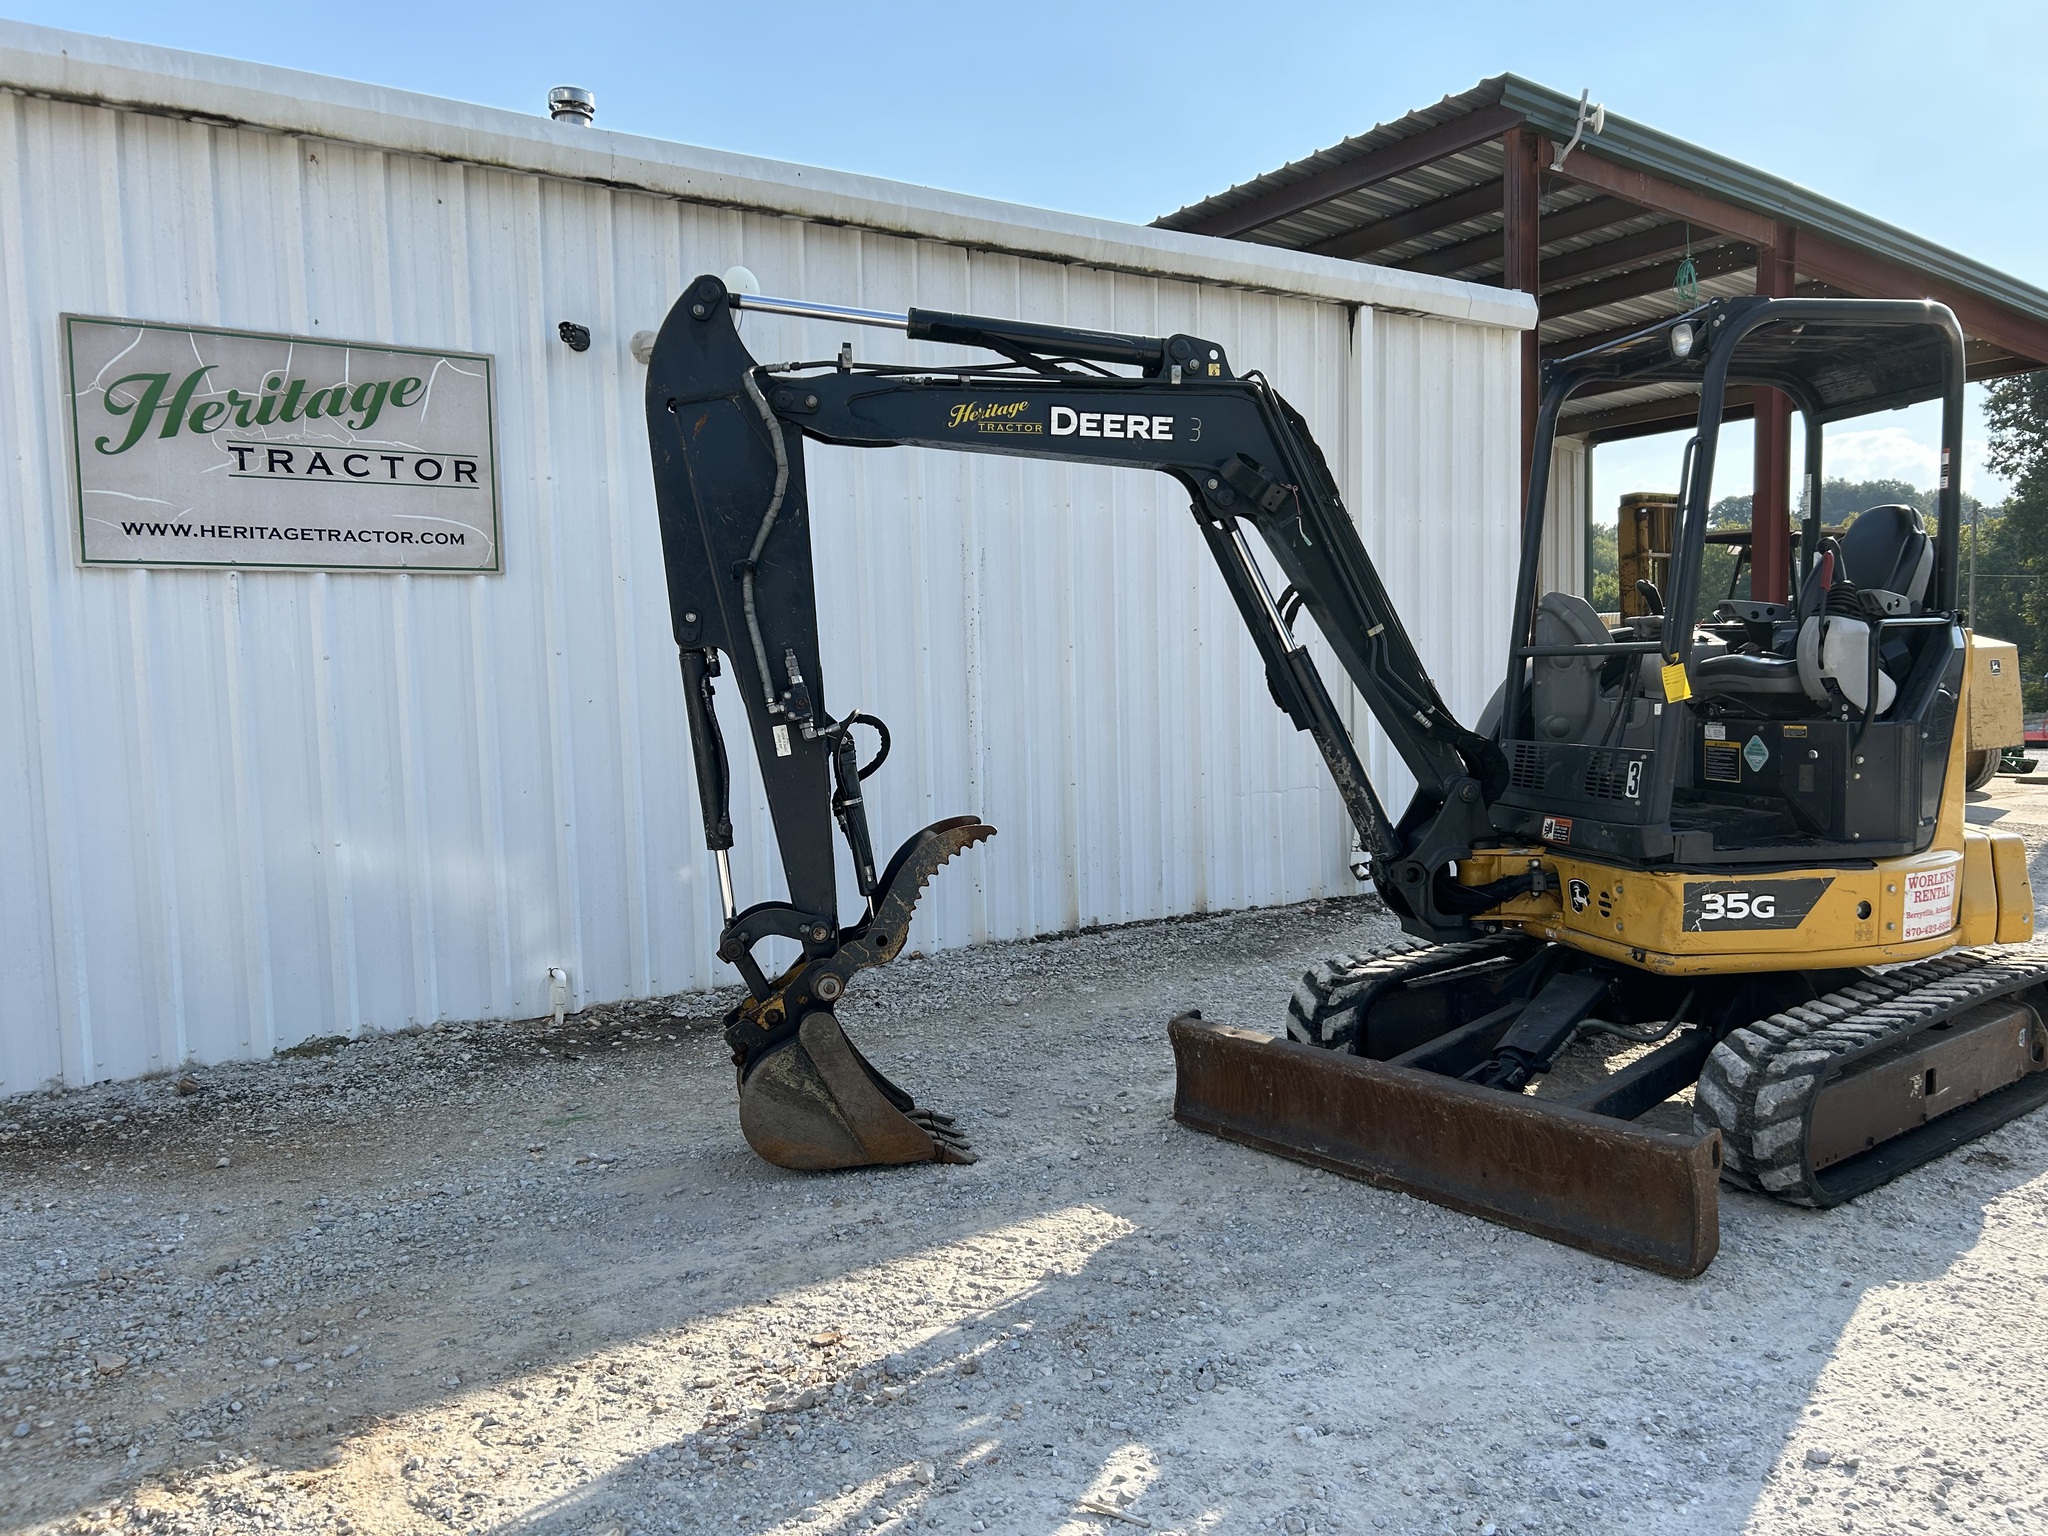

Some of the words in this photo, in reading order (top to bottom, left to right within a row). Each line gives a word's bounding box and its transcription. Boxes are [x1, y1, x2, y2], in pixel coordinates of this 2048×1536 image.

[94, 365, 428, 455] Heritage
[948, 400, 1029, 428] Heritage
[1050, 406, 1174, 440] DEERE
[978, 422, 1043, 433] TRACTOR
[1189, 417, 1202, 442] 3
[227, 446, 479, 484] TRACTOR
[121, 521, 466, 546] WWW.HERITAGETRACTOR.COM
[1628, 762, 1640, 796] 3
[1701, 892, 1775, 920] 35G
[1913, 885, 1951, 904] RENTAL
